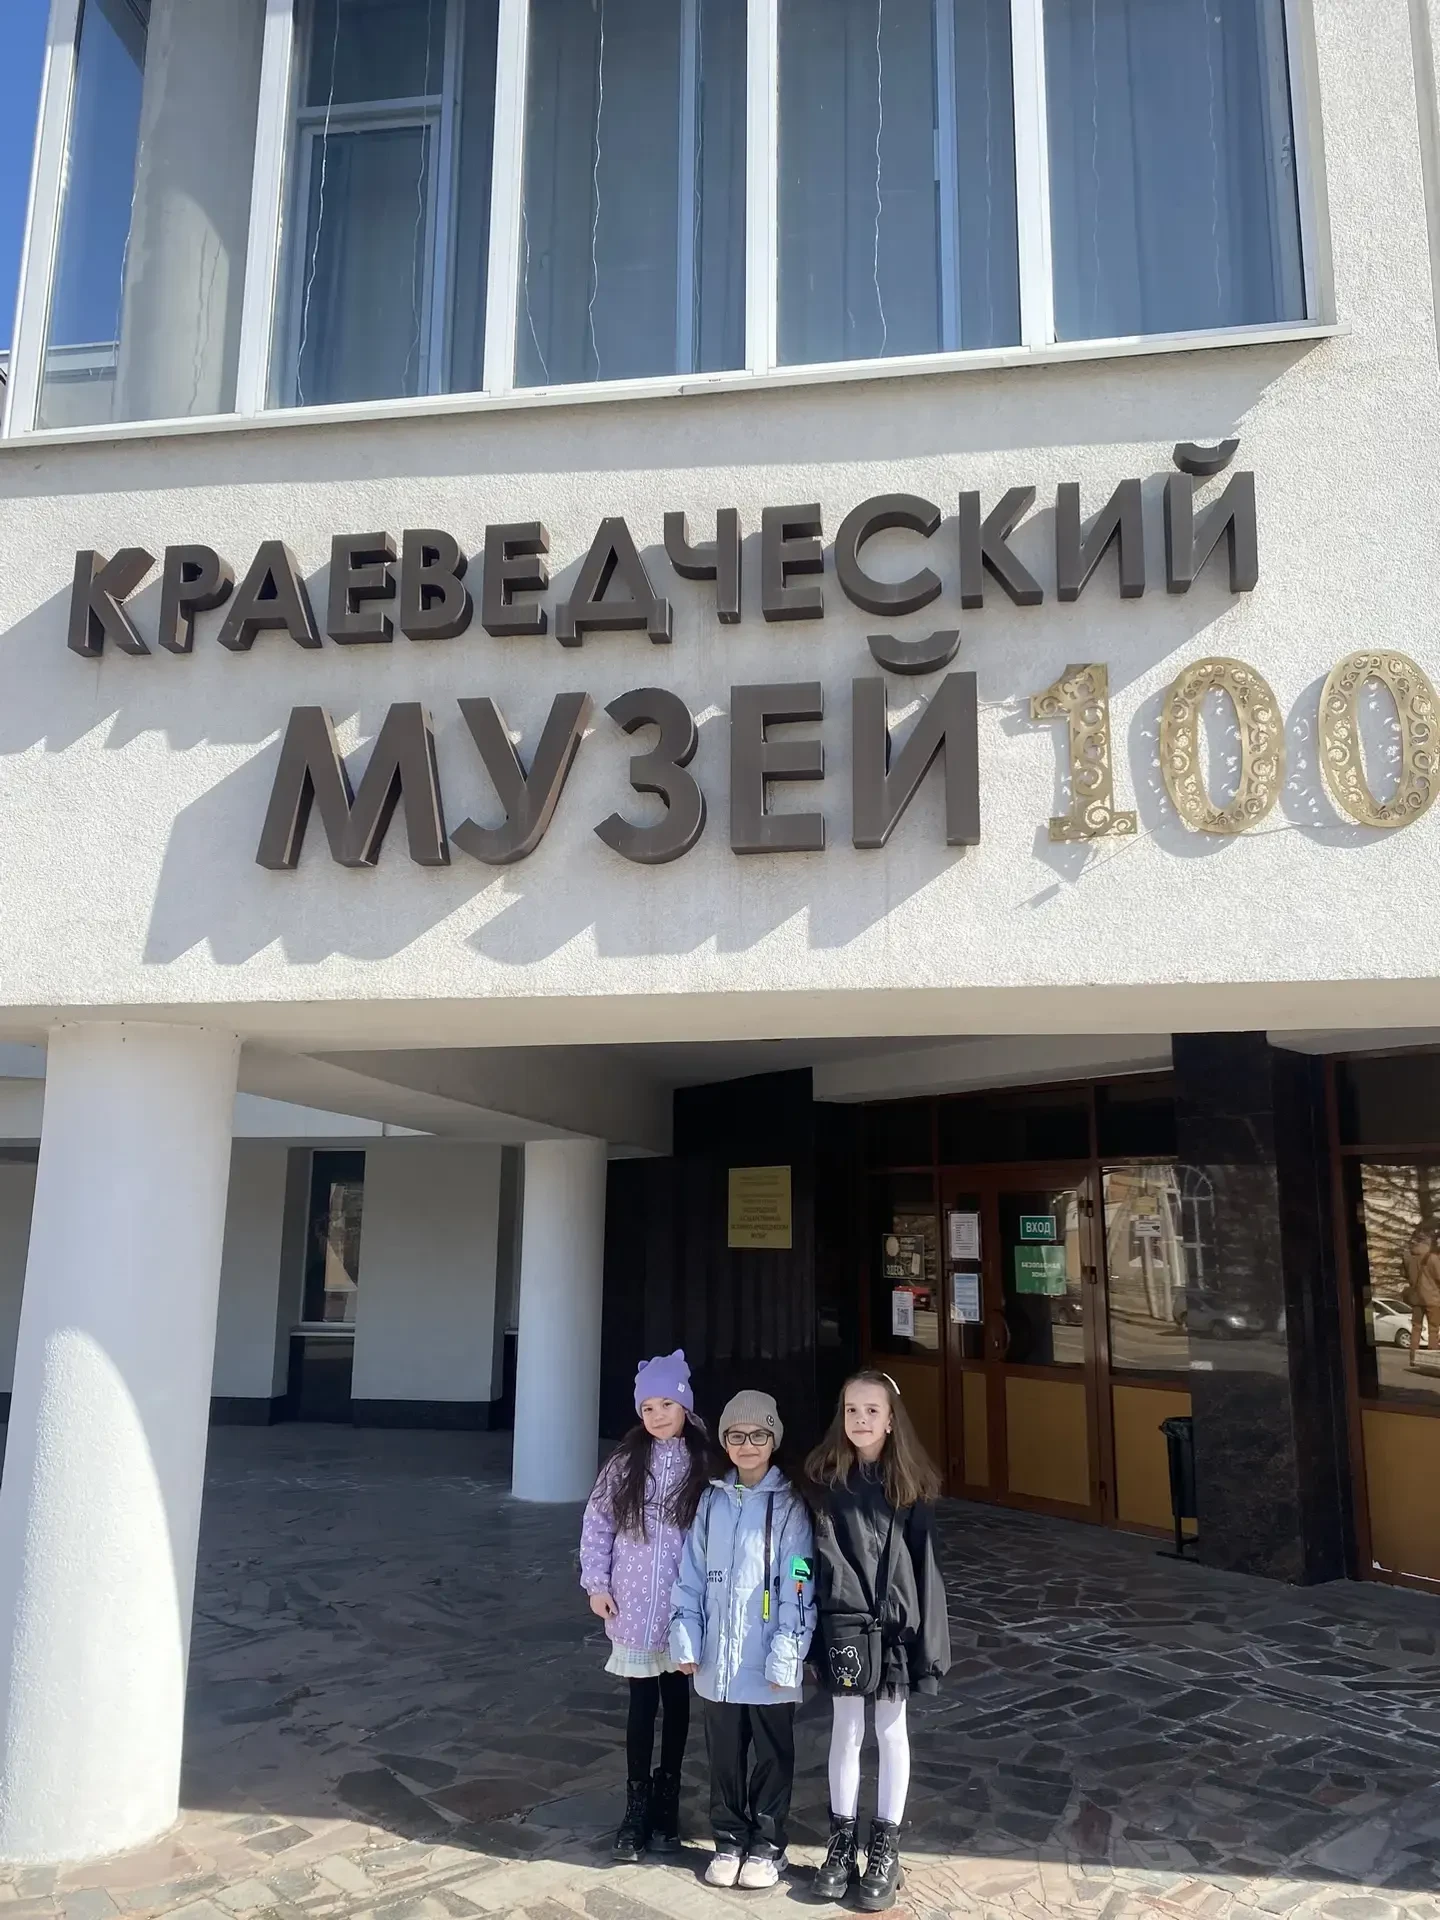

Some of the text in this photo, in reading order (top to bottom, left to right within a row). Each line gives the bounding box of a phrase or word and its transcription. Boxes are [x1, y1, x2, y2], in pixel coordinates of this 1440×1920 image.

[67, 439, 1258, 657] КРАЕВЕДЧЕСКИЙ
[256, 630, 981, 869] МУЗЕЙ
[1030, 649, 1440, 843] 100
[1026, 1221, 1051, 1235] ВХОД
